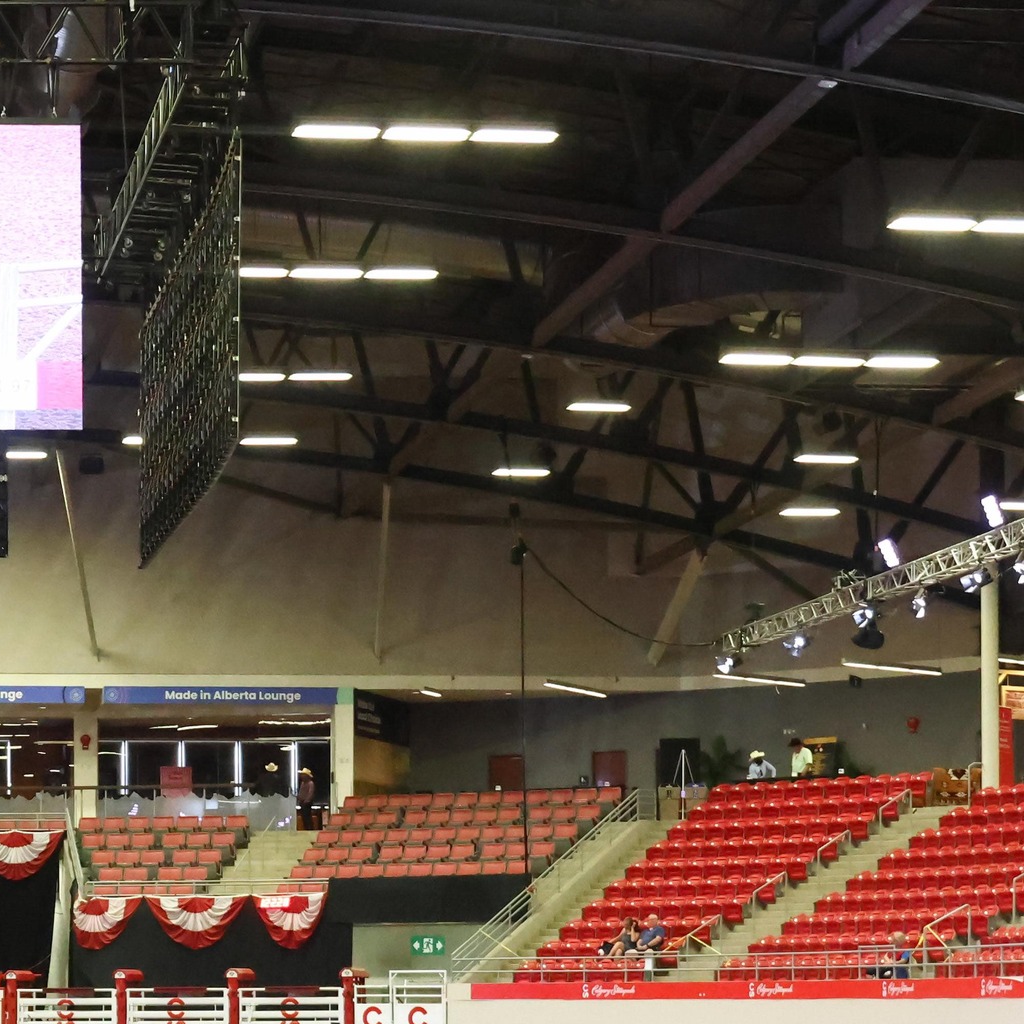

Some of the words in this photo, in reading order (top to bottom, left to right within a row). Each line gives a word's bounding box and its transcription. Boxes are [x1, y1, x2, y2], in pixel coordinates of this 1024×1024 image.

[164, 690, 198, 700] Made
[199, 690, 212, 700] in
[213, 690, 256, 701] Alberta
[258, 691, 302, 703] Lounge
